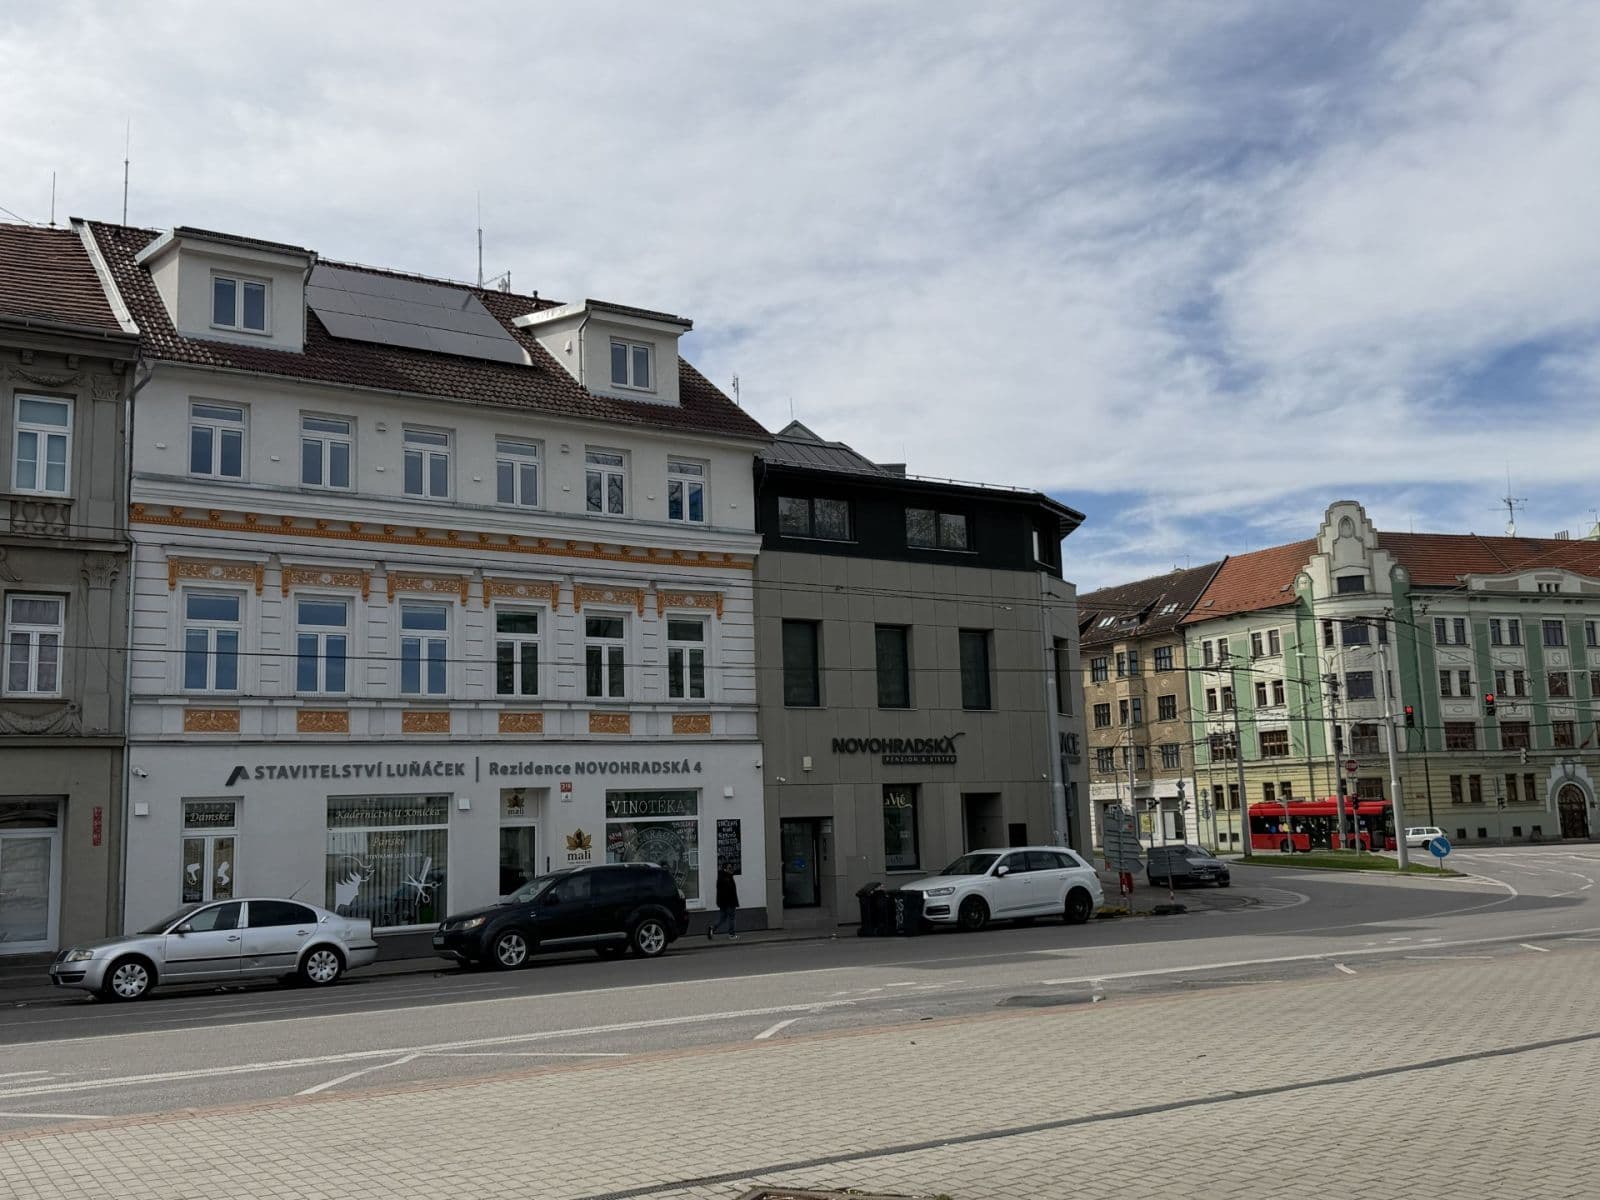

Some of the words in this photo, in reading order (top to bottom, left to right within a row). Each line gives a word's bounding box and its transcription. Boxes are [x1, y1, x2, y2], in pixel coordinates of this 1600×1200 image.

[254, 761, 382, 780] STAVITELSTVÍ
[386, 760, 465, 778] LUŇÁČEK
[489, 761, 571, 776] Rezidence
[574, 758, 690, 775] NOVOHRADSKÁ
[693, 761, 702, 774] 4
[611, 796, 685, 815] VINOTÉKA
[567, 850, 591, 860] mali
